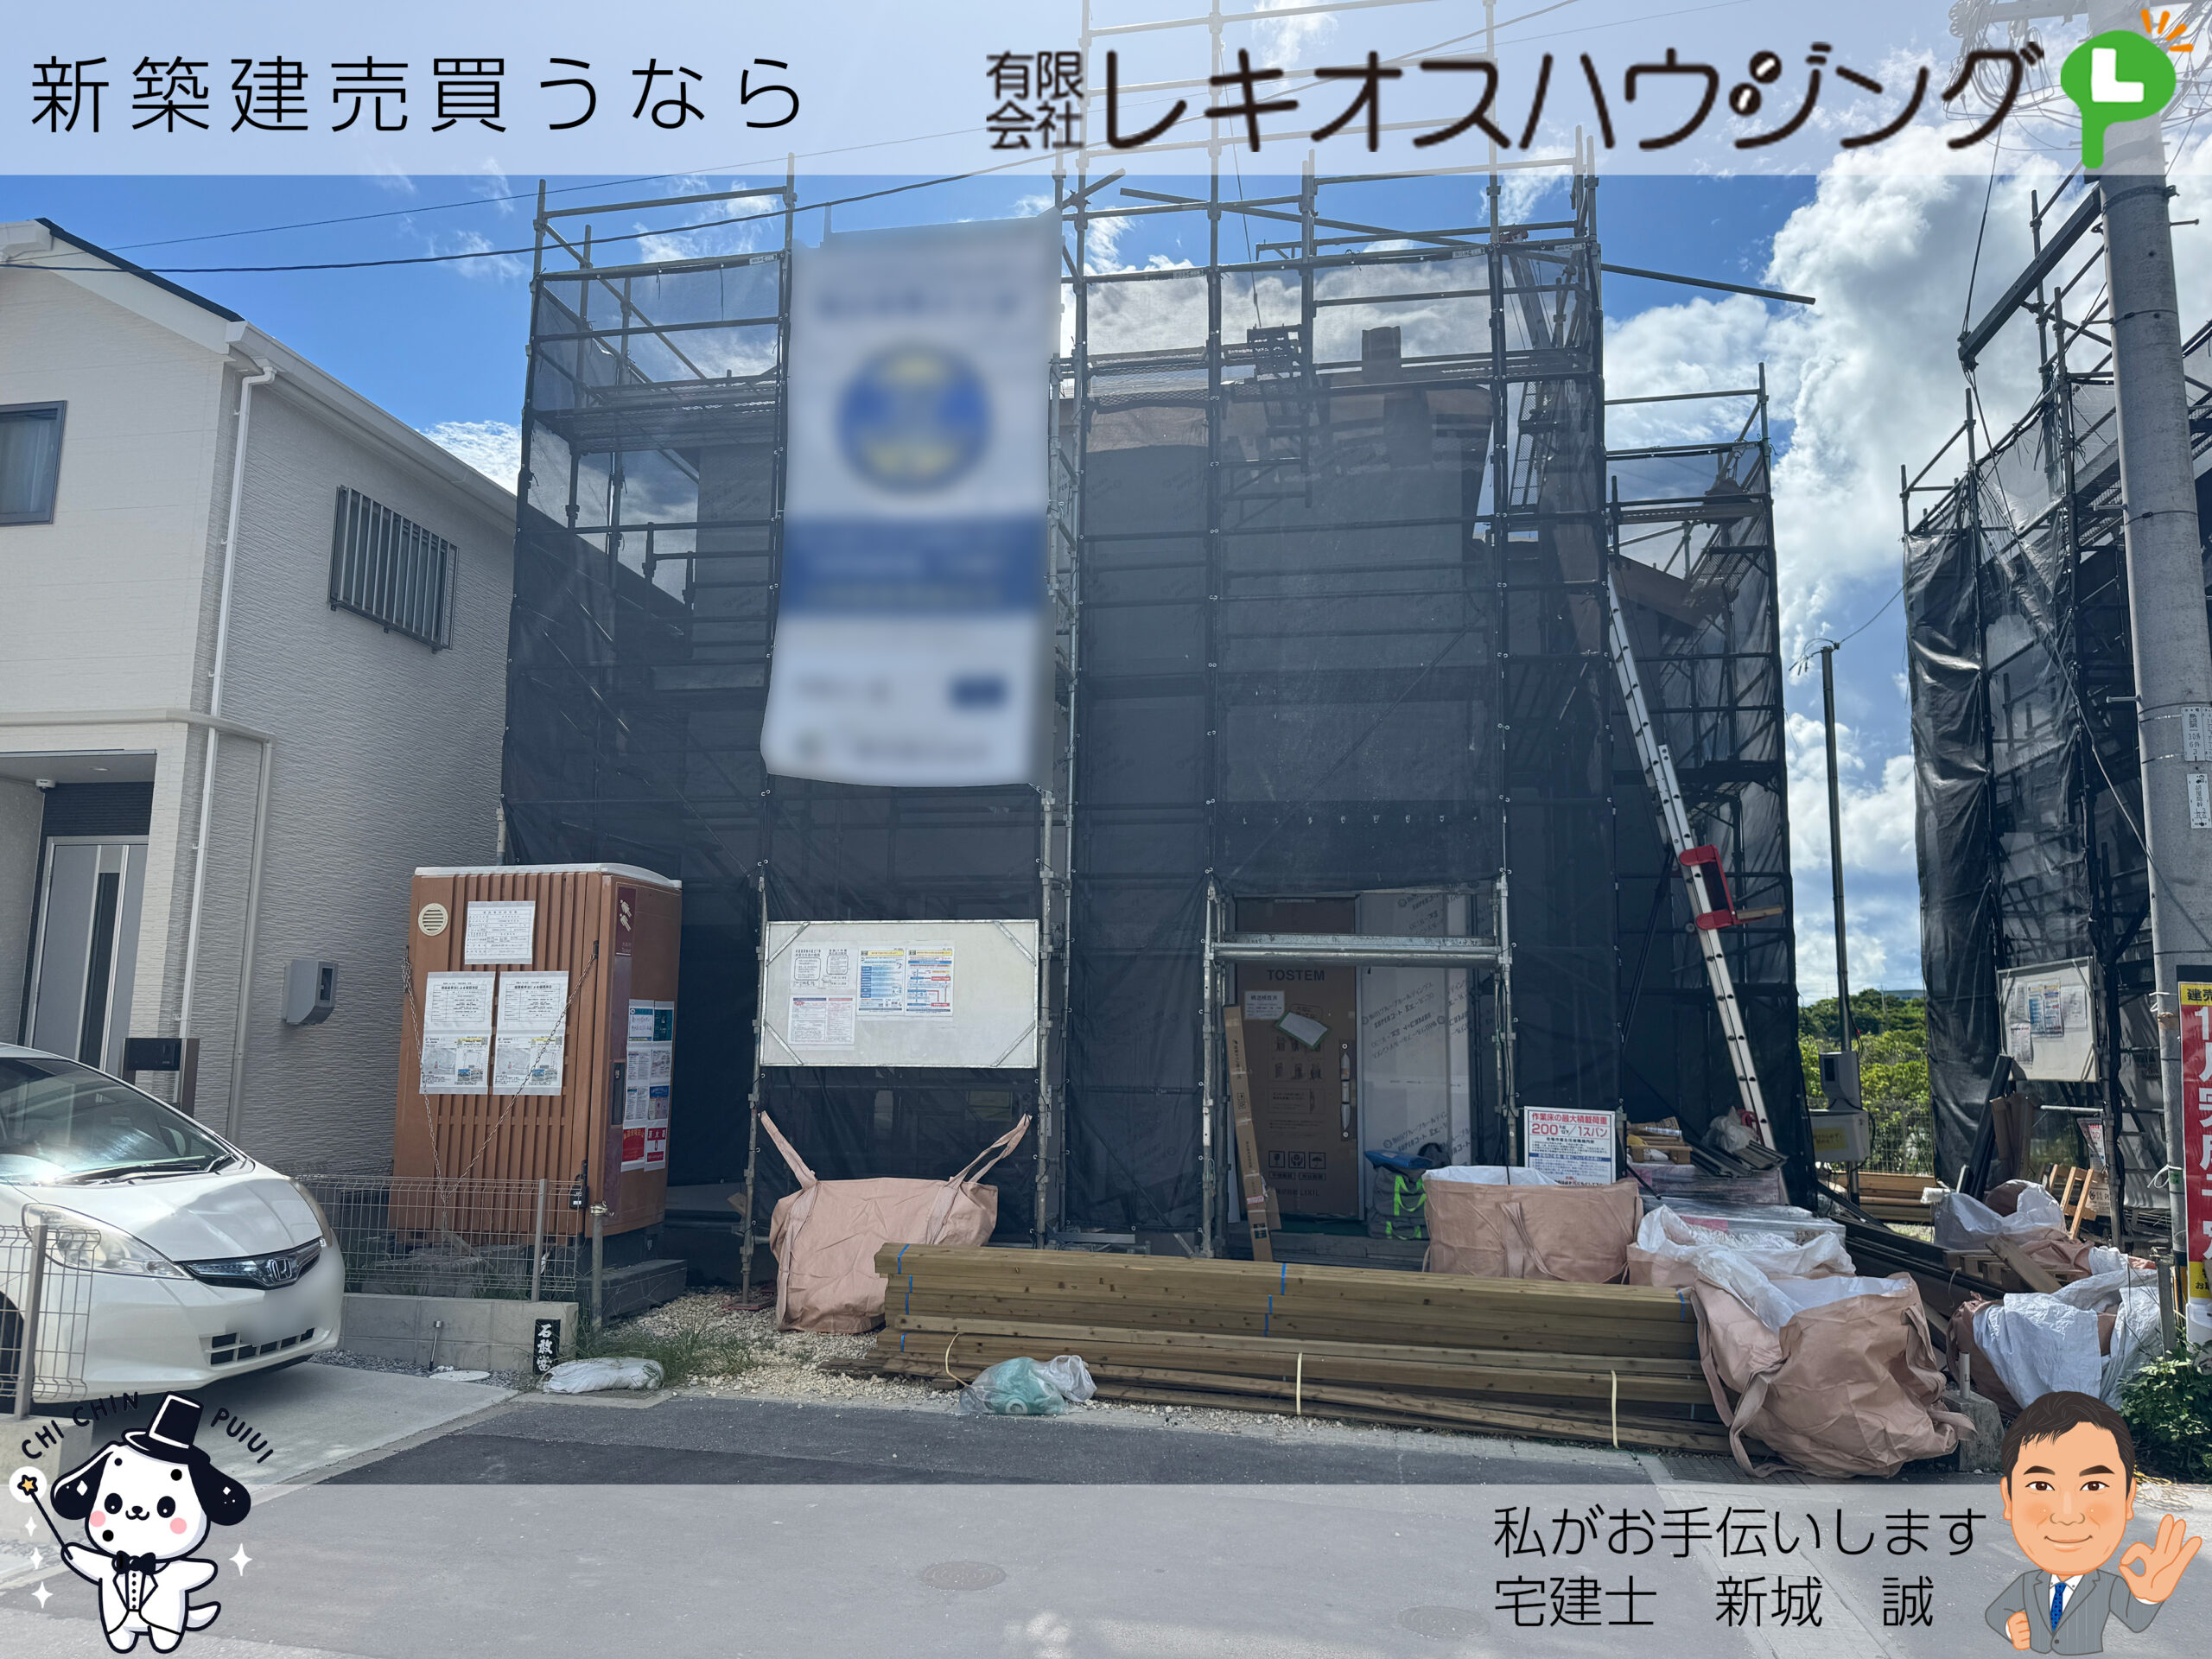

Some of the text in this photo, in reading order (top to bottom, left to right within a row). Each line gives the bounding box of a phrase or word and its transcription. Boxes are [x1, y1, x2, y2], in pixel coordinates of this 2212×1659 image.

[1267, 969, 1325, 981] TOSTEM
[1532, 1112, 1608, 1125] 作業床の最大積載荷重
[1531, 1123, 1559, 1135] 200
